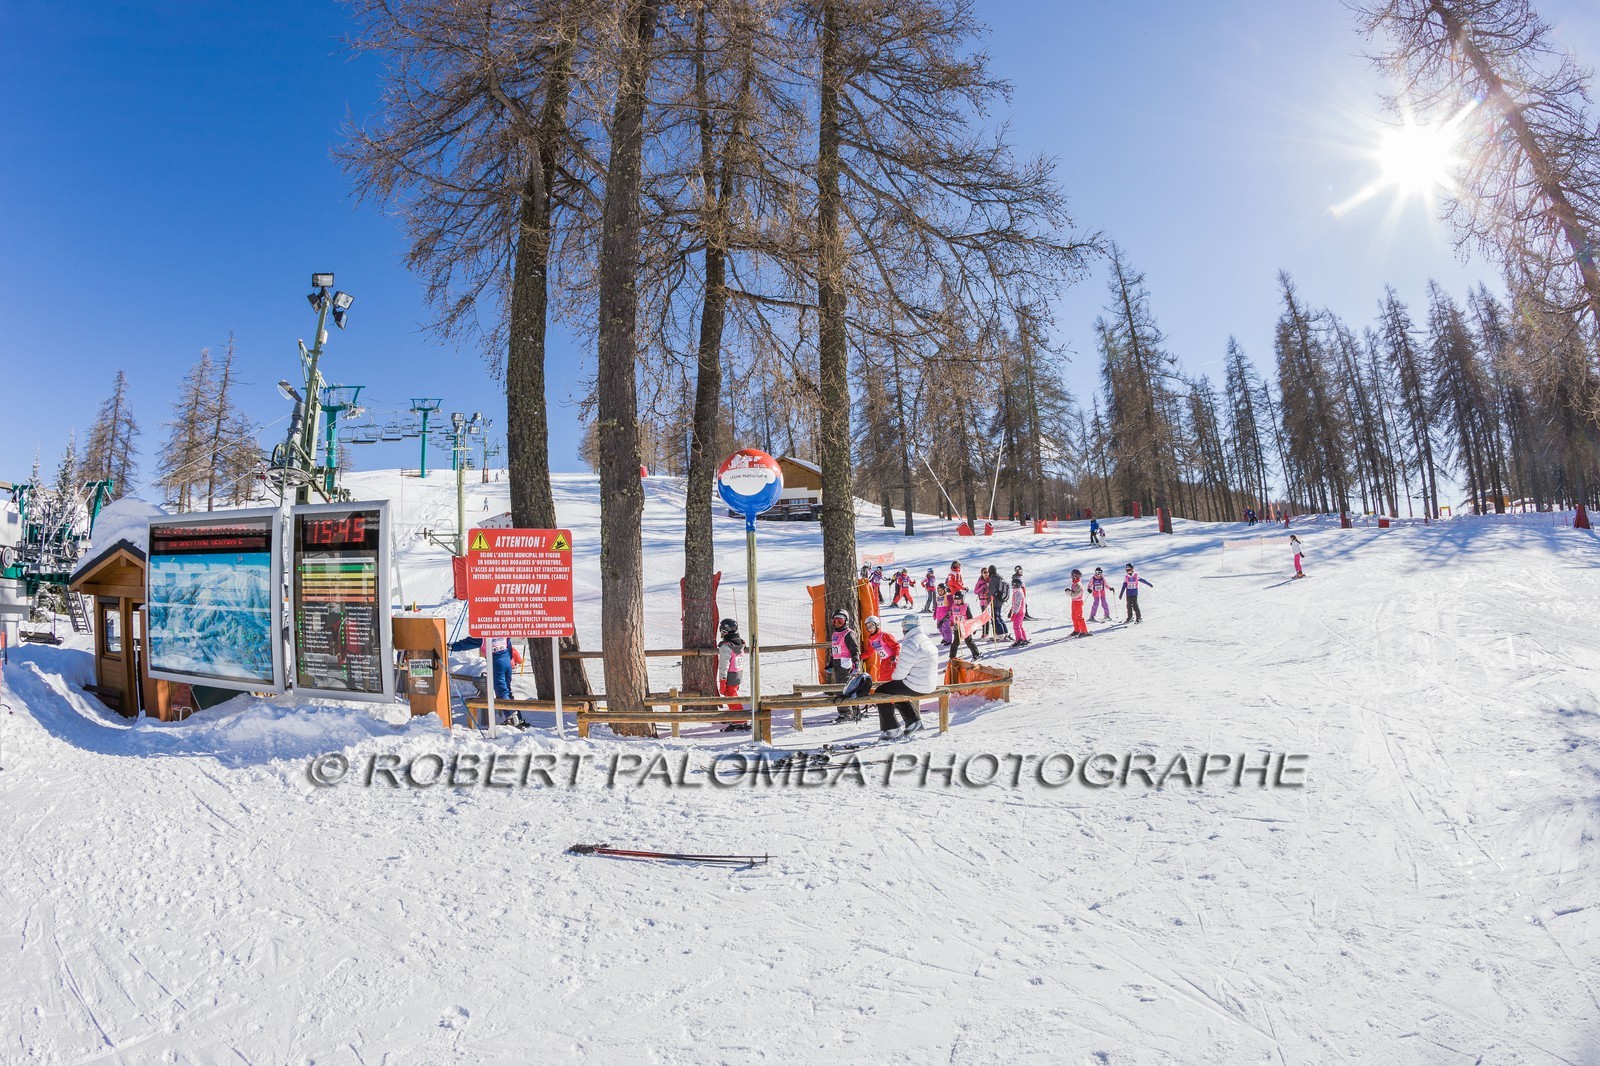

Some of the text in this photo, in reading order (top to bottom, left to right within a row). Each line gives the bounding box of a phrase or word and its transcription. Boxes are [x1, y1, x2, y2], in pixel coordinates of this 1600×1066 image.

[312, 517, 366, 544] 15:45
[494, 536, 546, 548] ATTENTION !
[494, 584, 547, 594] ATTENTION !
